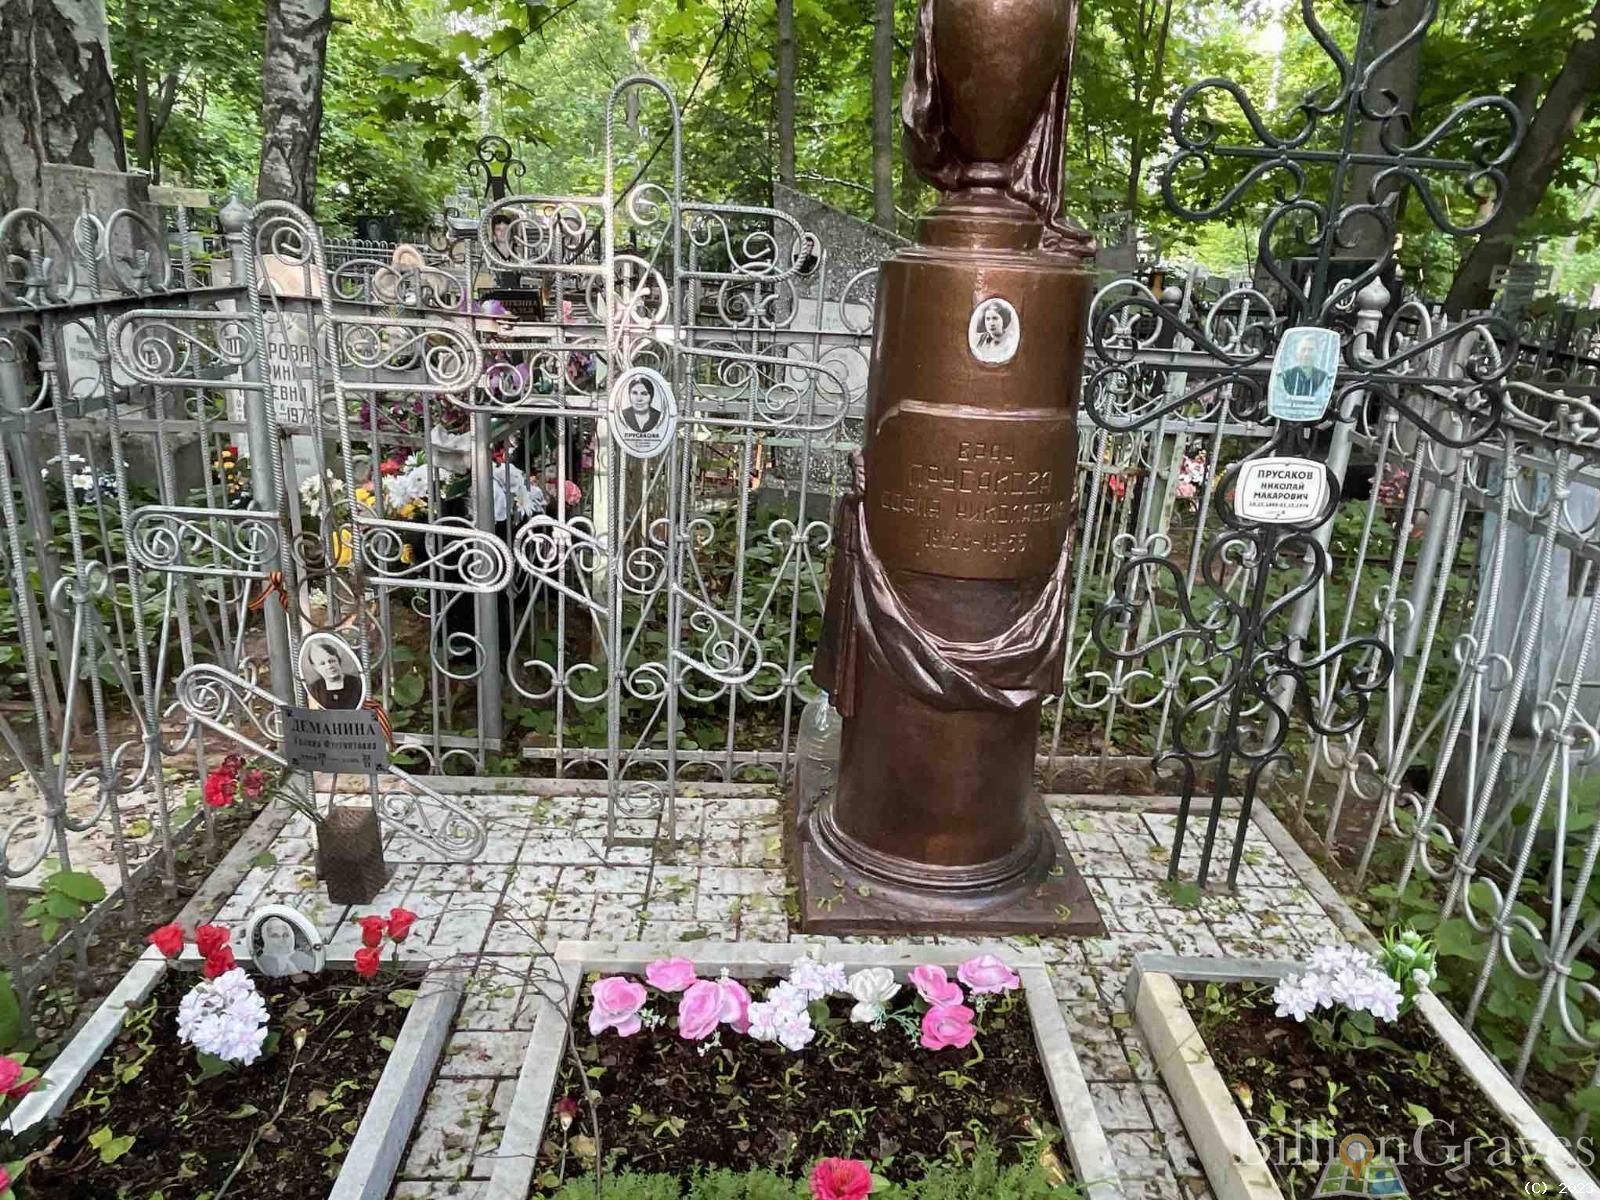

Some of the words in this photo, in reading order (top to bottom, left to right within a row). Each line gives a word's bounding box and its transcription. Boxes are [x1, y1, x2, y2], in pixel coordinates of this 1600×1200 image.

[1257, 469, 1314, 480] ПРУСАКОВ
[1260, 481, 1305, 491] НИКОЛАЙ
[1253, 492, 1309, 501] МАКАРОВИЧ
[291, 718, 376, 737] ДЕМАНИНА
